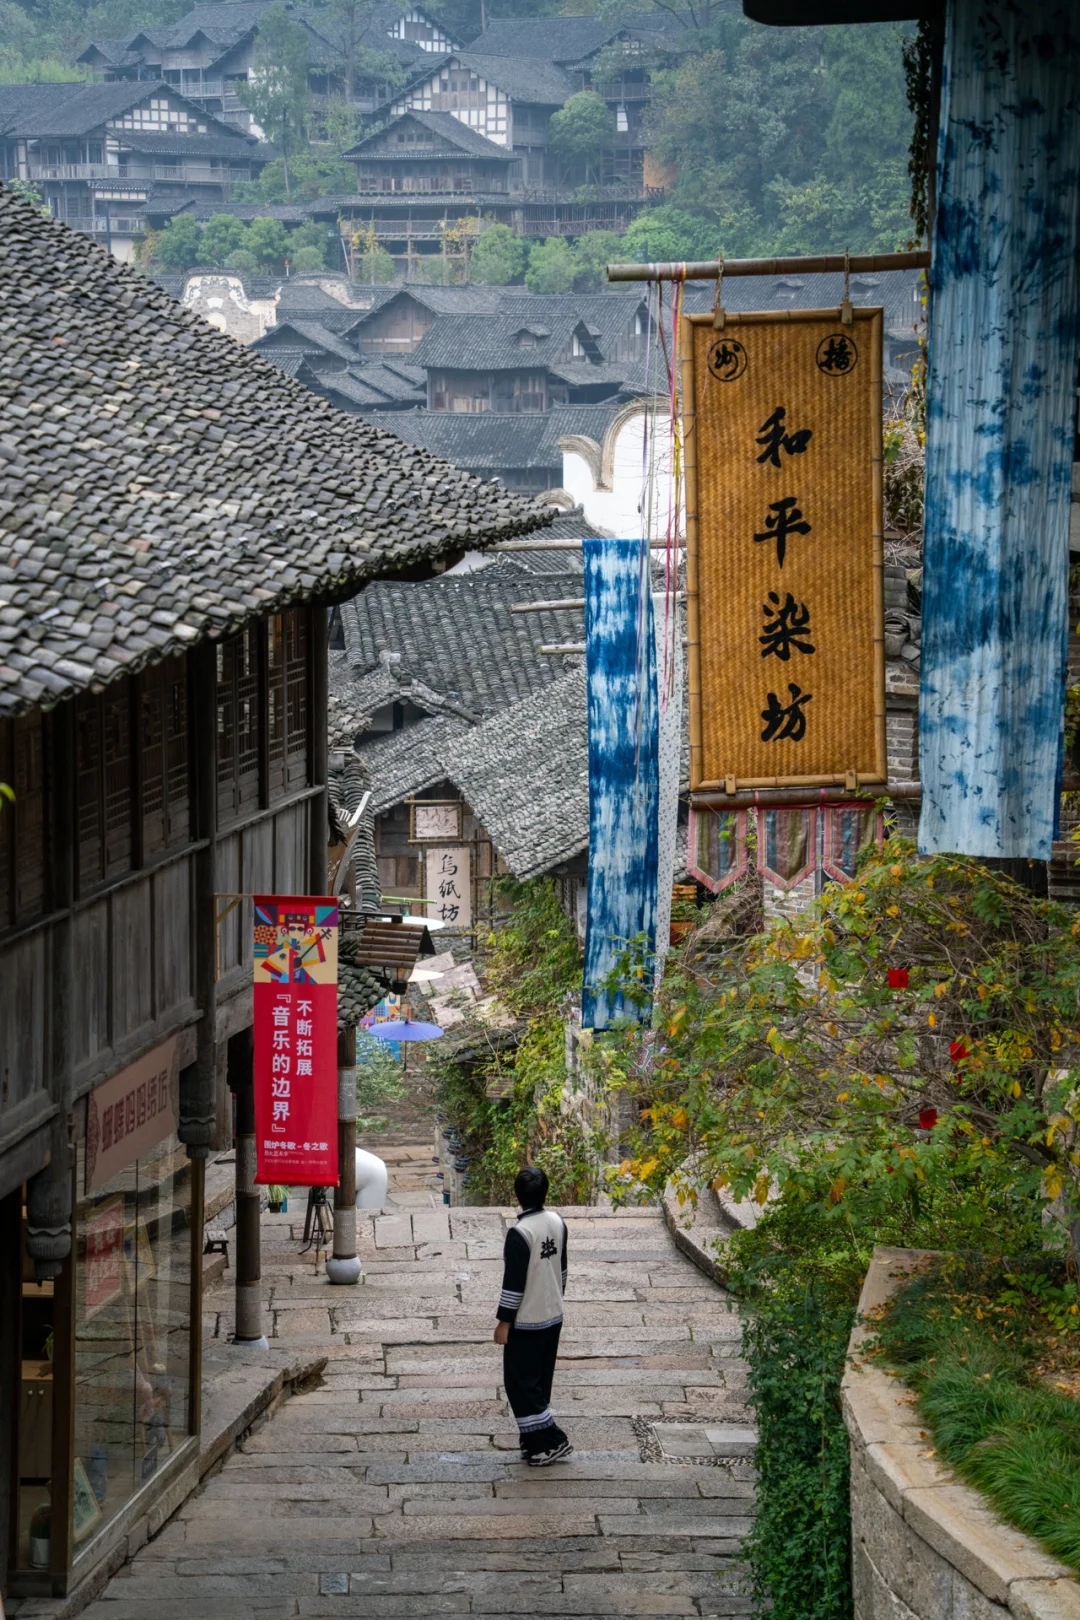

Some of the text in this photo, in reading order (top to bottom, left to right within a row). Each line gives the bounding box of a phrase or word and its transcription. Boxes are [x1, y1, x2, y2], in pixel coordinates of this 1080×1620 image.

[754, 406, 815, 742] 和平染坊
[296, 999, 313, 1076] 不断拓展
